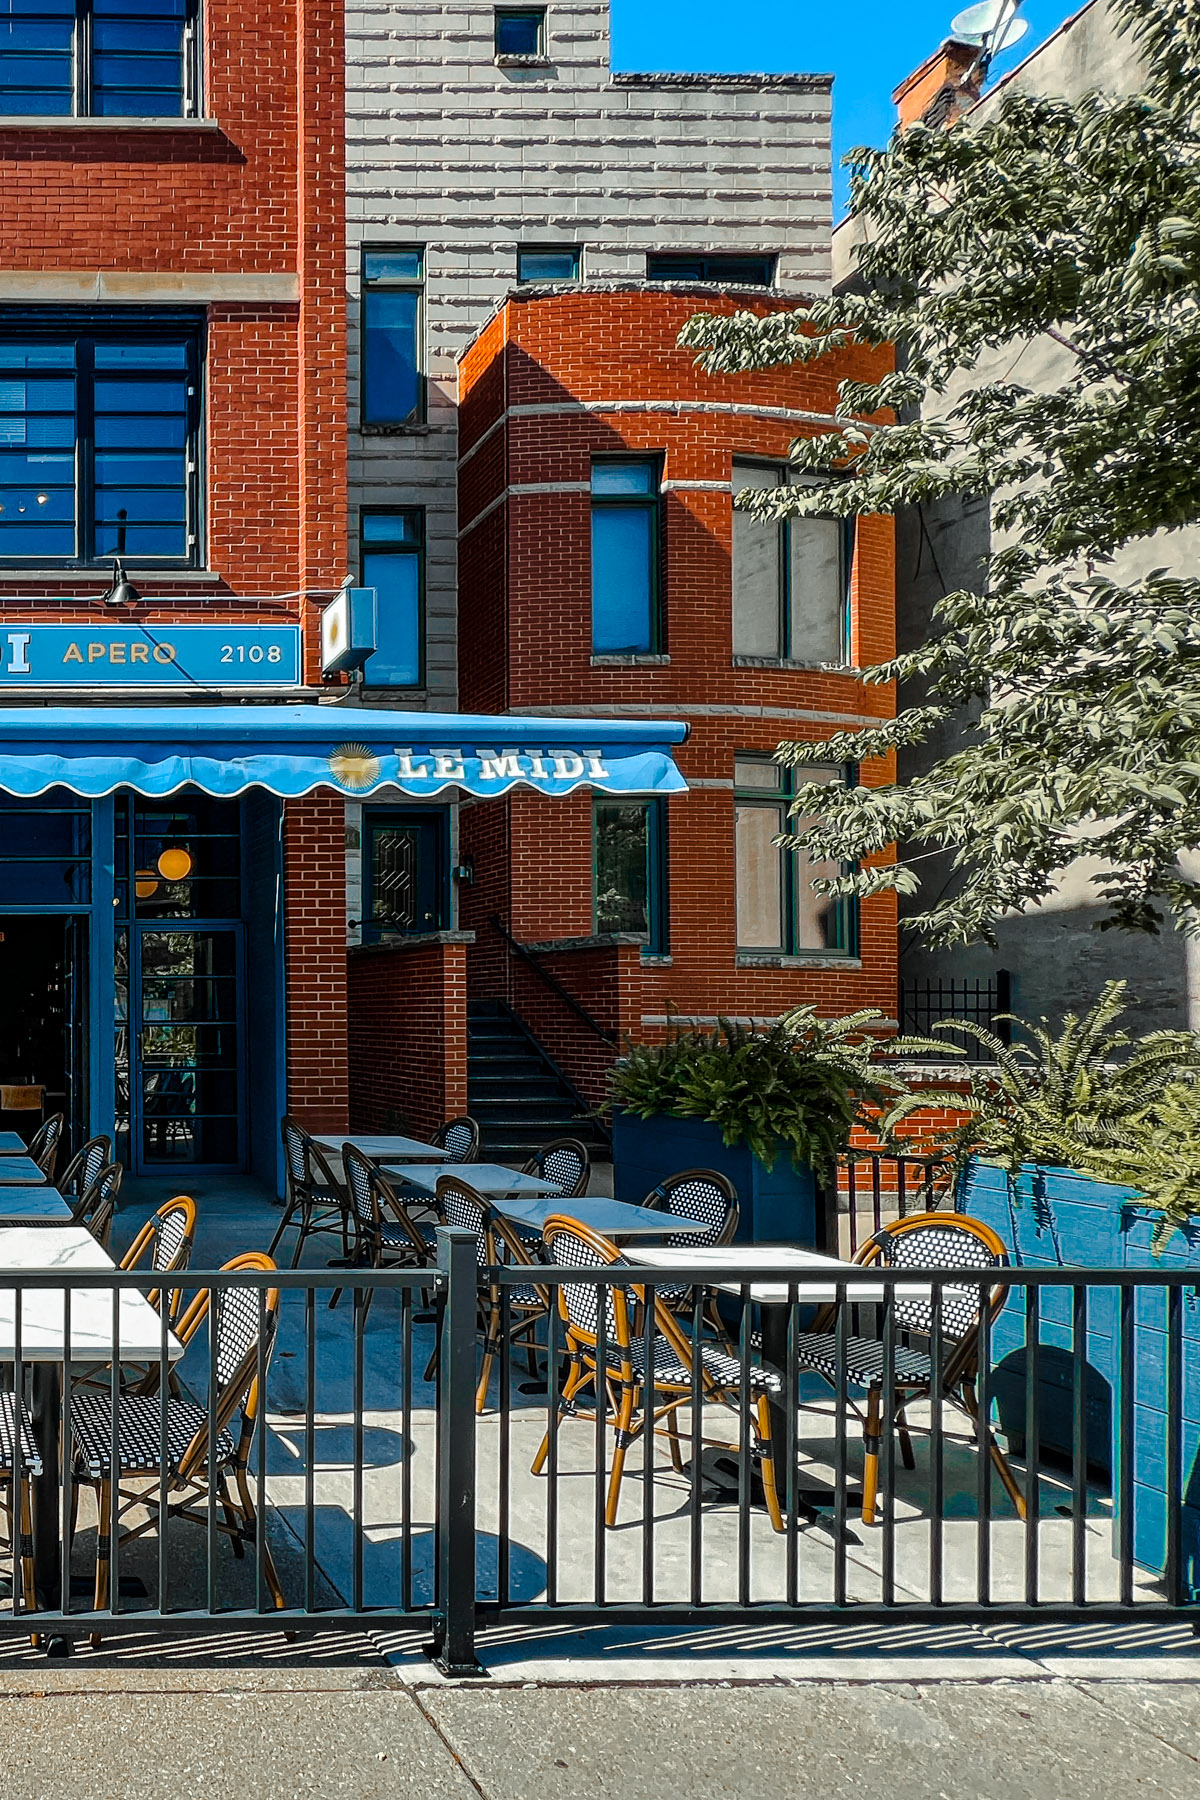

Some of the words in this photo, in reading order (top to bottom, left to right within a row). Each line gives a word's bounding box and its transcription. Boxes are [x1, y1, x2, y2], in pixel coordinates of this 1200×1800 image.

[62, 642, 177, 665] APERO
[219, 645, 282, 663] 2108
[394, 747, 466, 780] LE
[475, 747, 610, 780] MIDI
